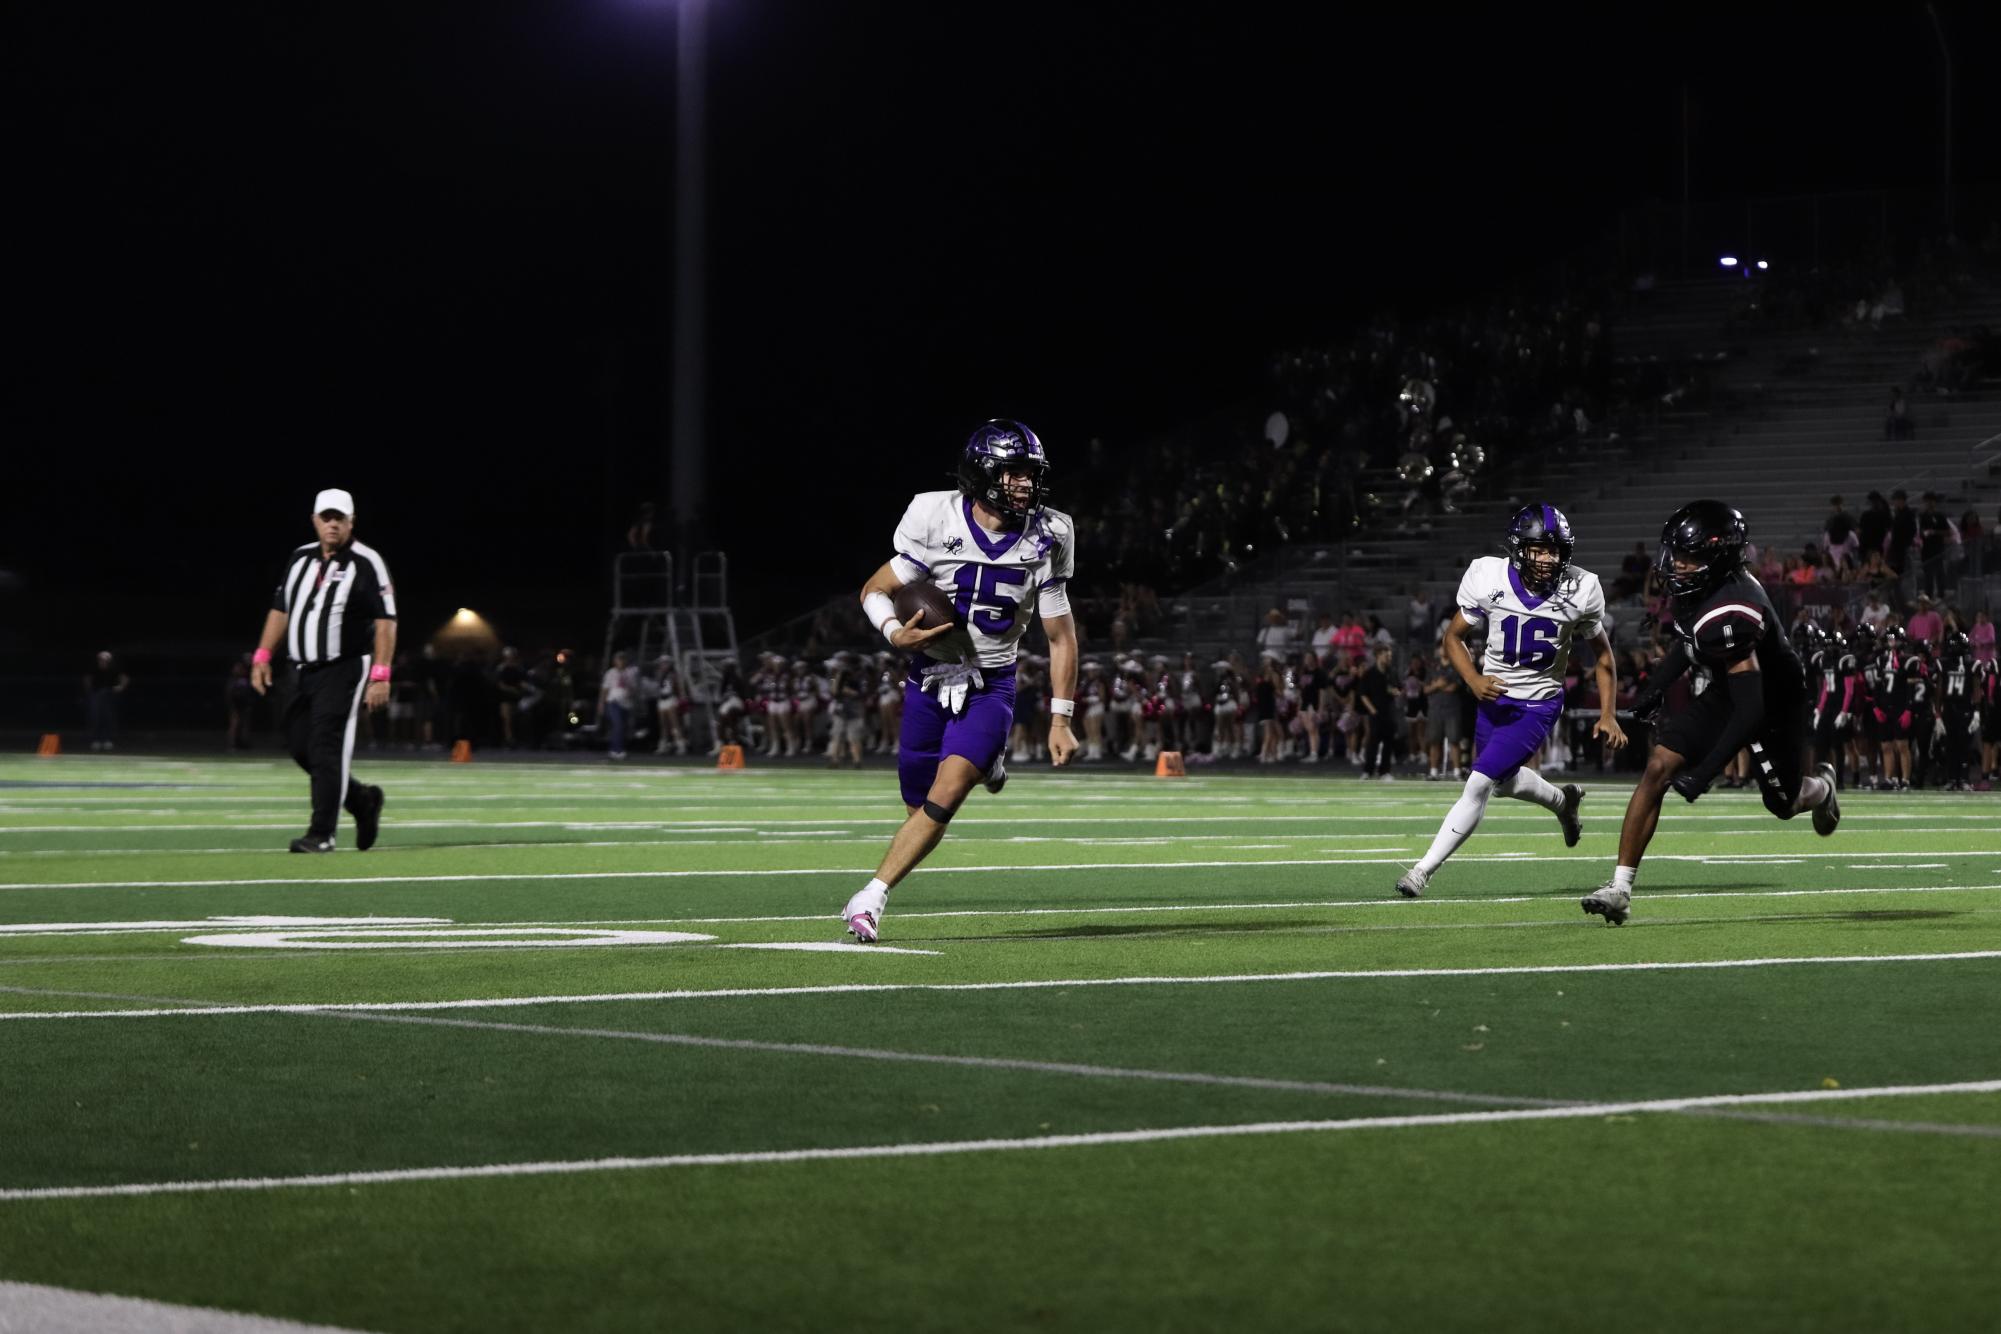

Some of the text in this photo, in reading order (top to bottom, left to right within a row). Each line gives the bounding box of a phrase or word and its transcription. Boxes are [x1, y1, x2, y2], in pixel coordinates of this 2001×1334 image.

[953, 562, 1026, 635] 15
[1501, 615, 1558, 671] 16
[1947, 676, 1965, 695] 14
